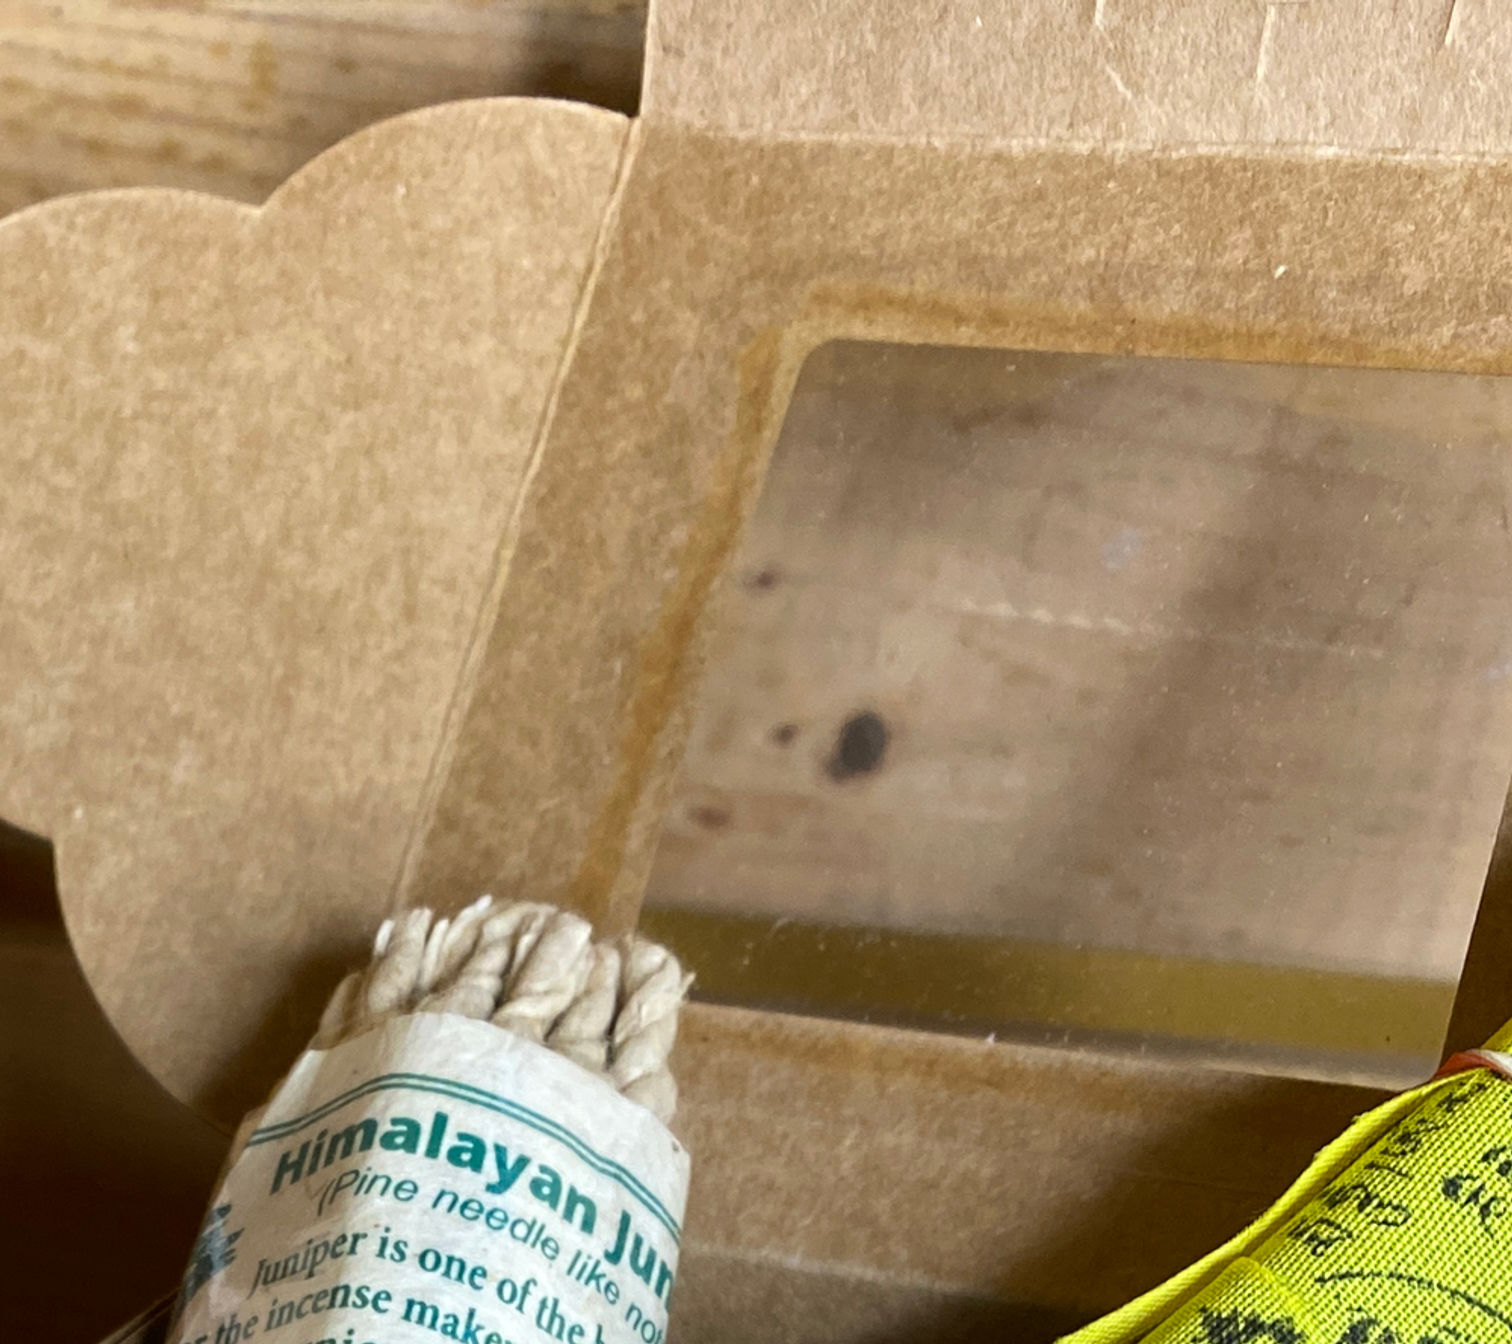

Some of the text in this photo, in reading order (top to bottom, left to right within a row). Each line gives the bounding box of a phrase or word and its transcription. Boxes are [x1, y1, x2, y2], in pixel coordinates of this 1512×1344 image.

[269, 1111, 597, 1236] Himalayan
[247, 1231, 368, 1299] Juniper
[376, 1226, 409, 1264] is
[419, 1248, 487, 1290] one
[497, 1278, 537, 1314] of
[316, 1166, 419, 1217] (Pine
[431, 1187, 560, 1261] needle
[566, 1249, 620, 1305] like
[264, 1284, 392, 1332] incense
